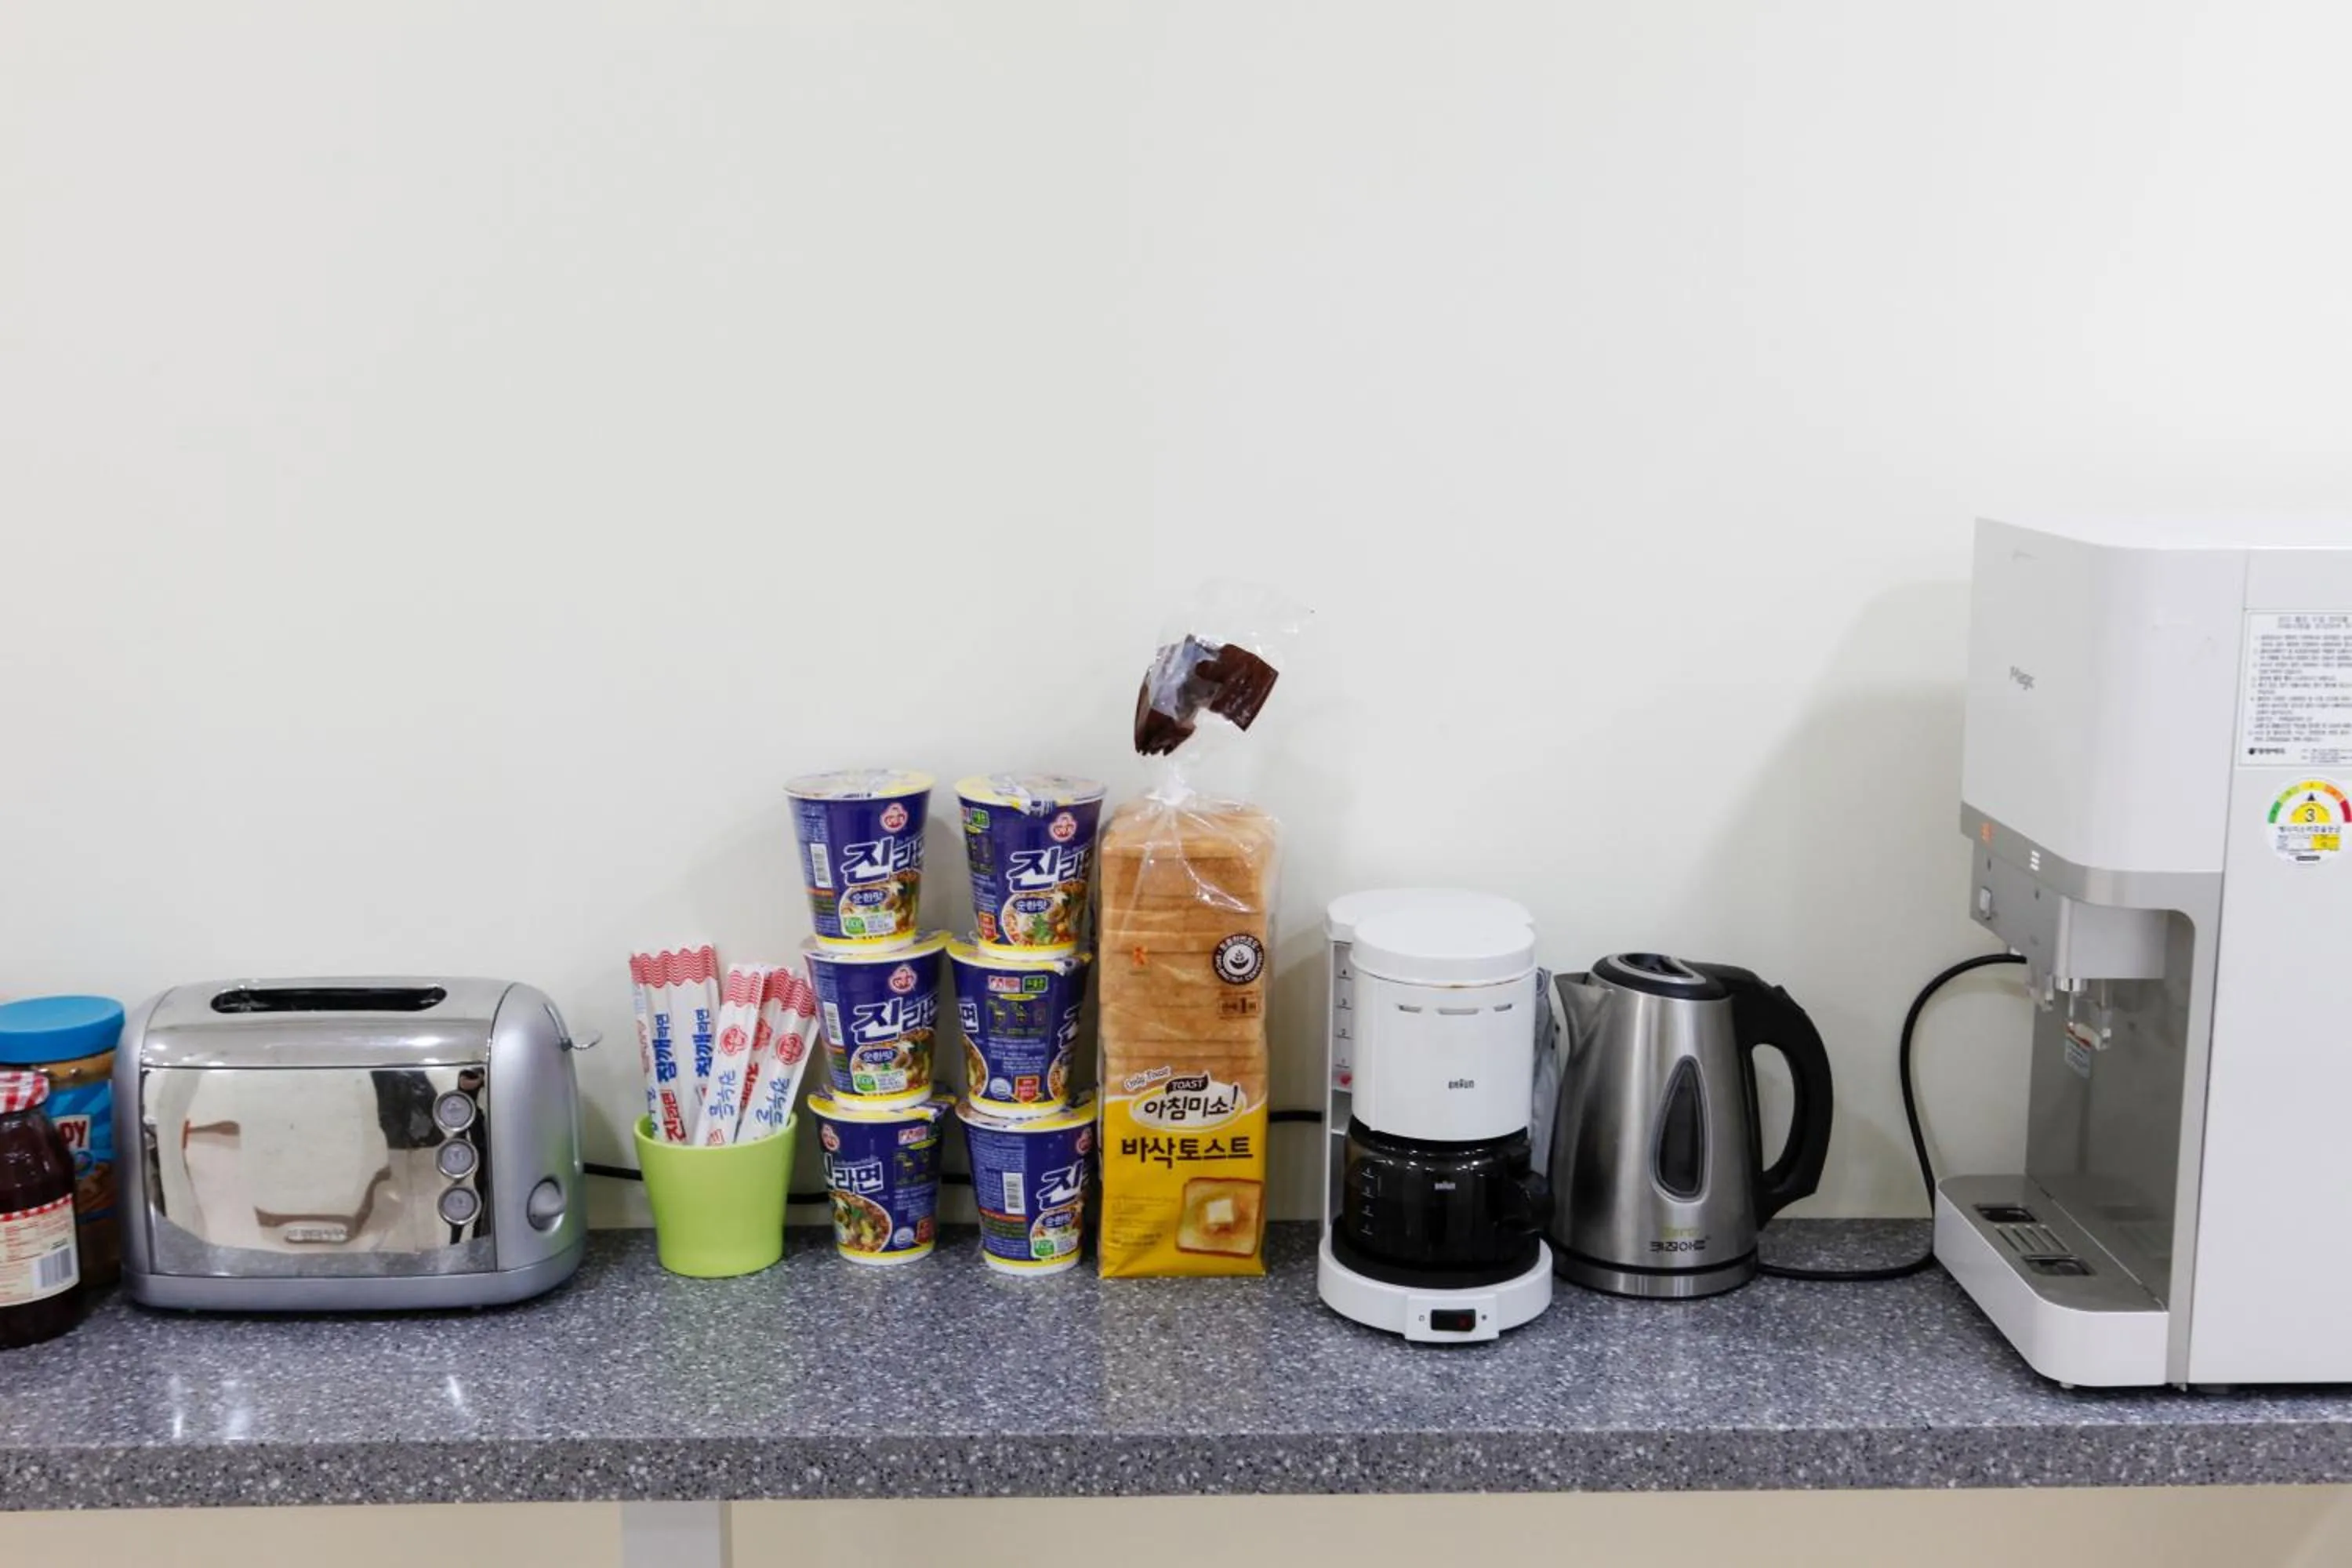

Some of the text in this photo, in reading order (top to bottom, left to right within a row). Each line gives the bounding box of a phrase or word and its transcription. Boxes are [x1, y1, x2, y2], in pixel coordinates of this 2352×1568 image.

[2306, 808, 2315, 822] 3
[1007, 845, 1091, 893] 진라
[652, 1013, 677, 1084] 참깨라면
[1144, 1085, 1239, 1120] 아침미소!
[1171, 1079, 1203, 1091] TOAST
[659, 1089, 687, 1142] 진라면
[1121, 1137, 1254, 1169] 바삭토스트
